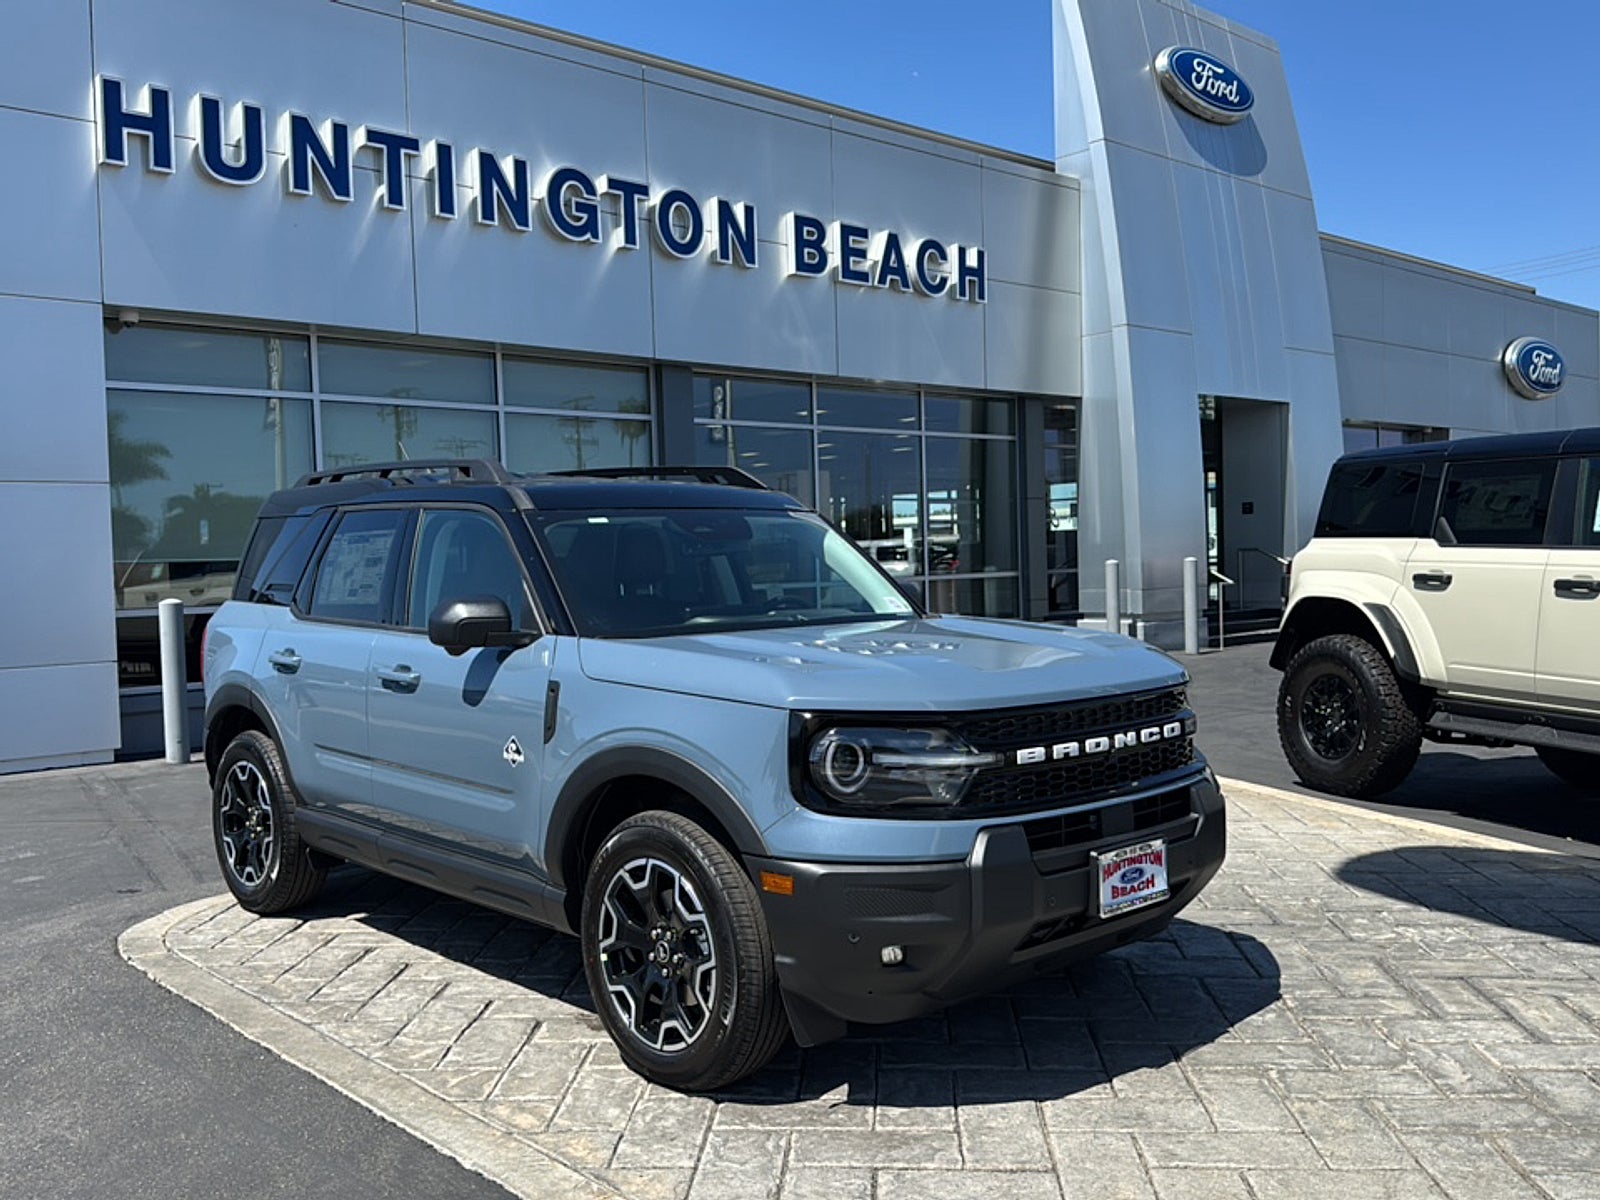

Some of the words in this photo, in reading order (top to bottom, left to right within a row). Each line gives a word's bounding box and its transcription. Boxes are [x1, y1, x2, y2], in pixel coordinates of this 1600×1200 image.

[1191, 58, 1240, 103] Ford
[98, 74, 759, 269] HUNTINGTON
[787, 211, 988, 303] BEACH
[1529, 350, 1561, 385] Ford
[1016, 721, 1182, 765] BRONCO
[1103, 847, 1163, 882] HUNTINGTON
[1111, 873, 1155, 900] BEACH
